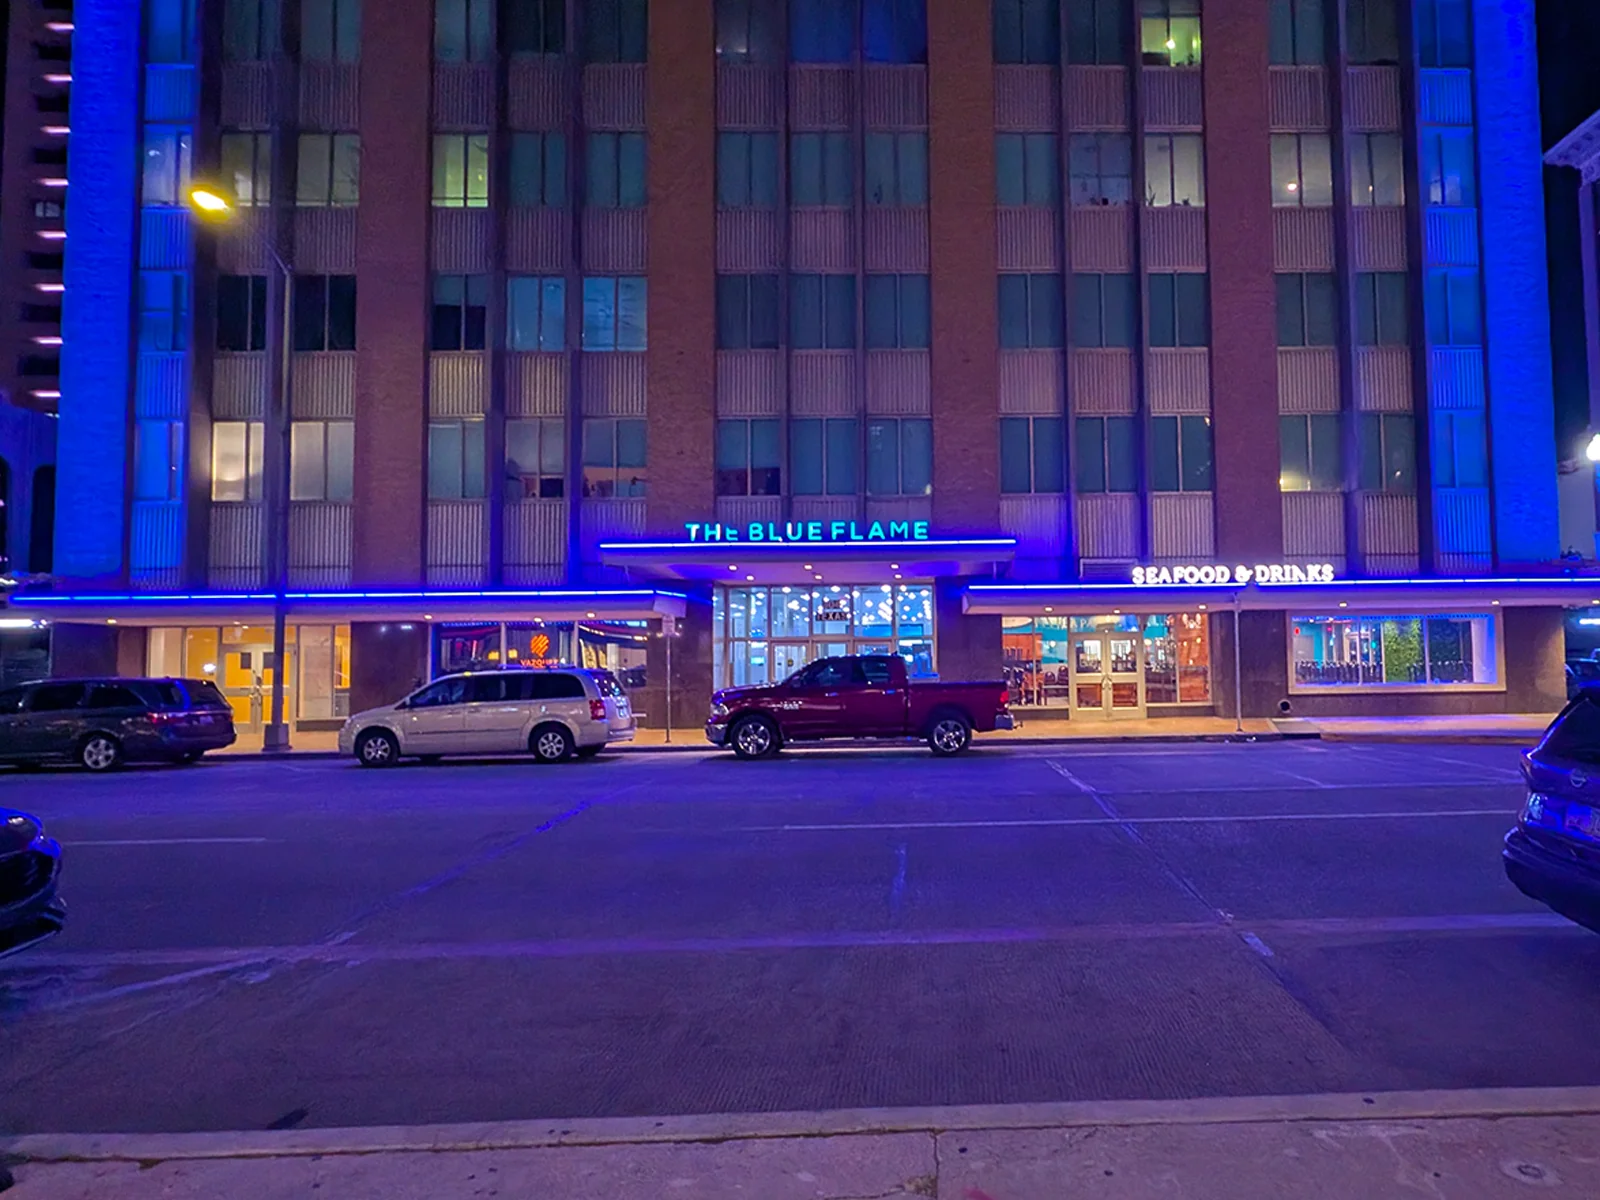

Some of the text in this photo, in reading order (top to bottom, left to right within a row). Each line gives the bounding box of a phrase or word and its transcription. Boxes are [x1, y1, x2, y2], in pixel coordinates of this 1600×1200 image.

[685, 521, 928, 542] THE BLUE FLAME
[1132, 564, 1334, 584] SEAFOOD & DRINKS
